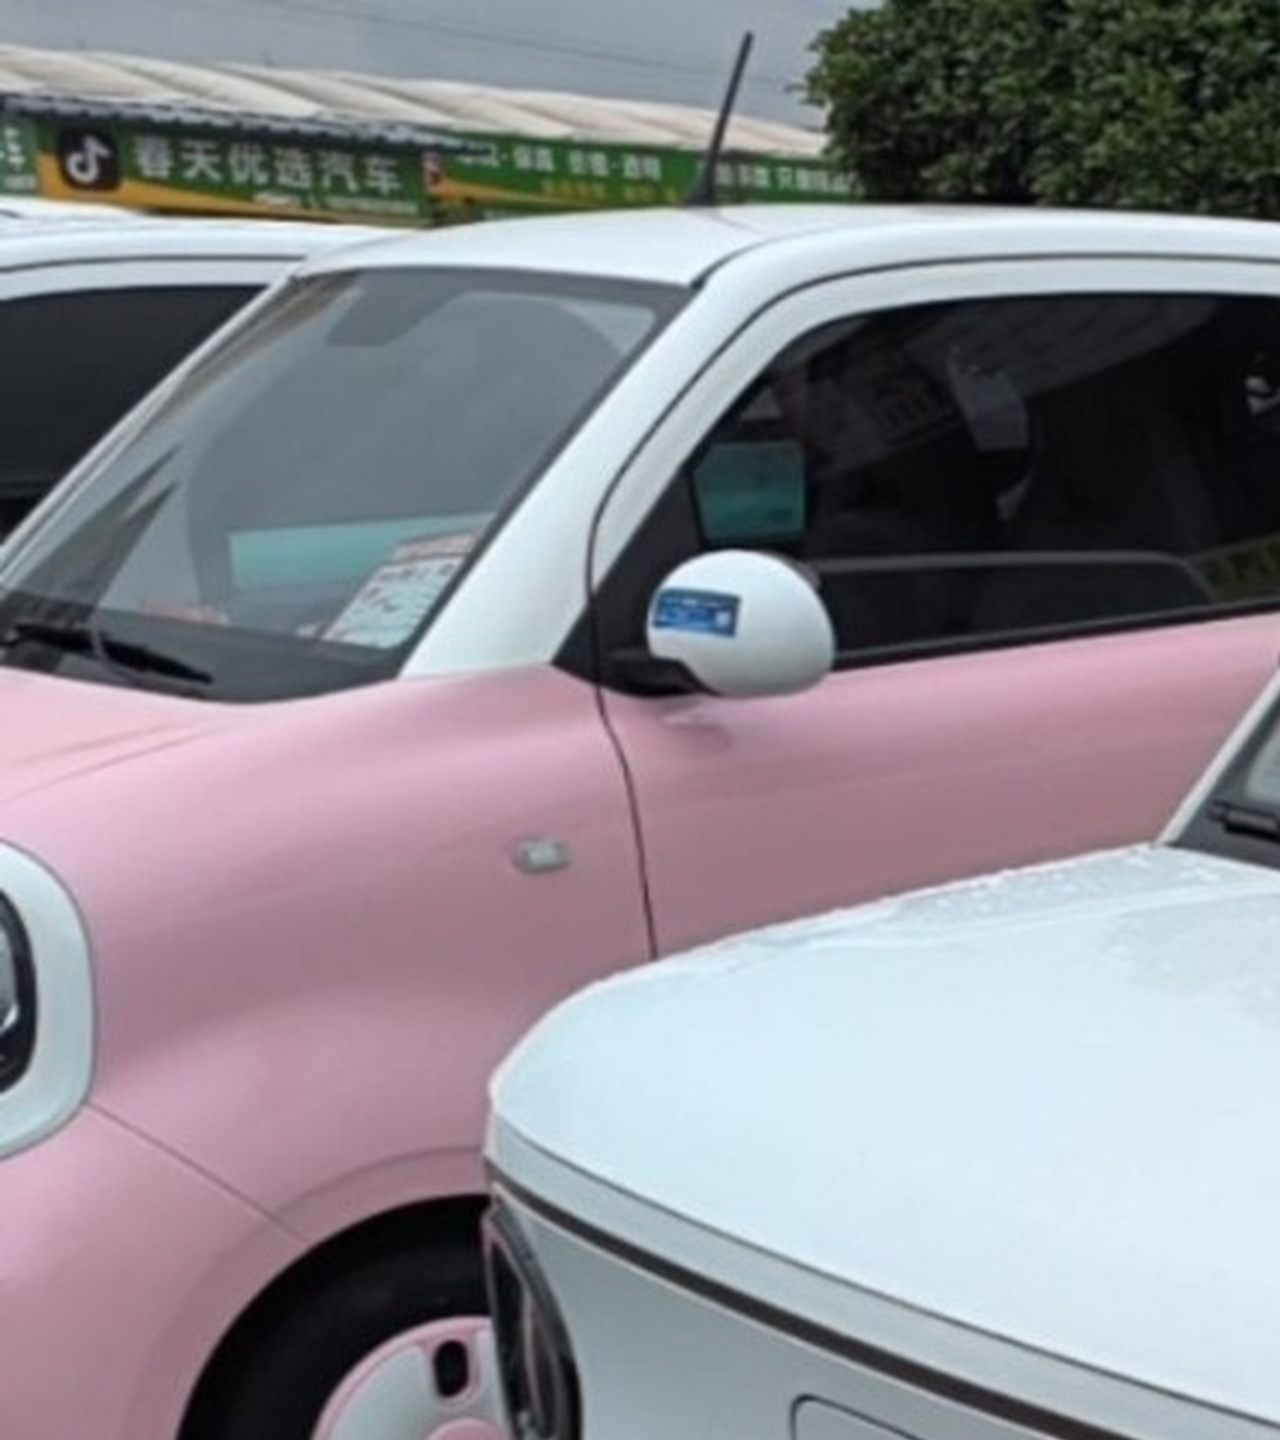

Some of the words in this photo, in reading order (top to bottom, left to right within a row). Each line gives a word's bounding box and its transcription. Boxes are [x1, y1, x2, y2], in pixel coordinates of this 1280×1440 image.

[134, 137, 400, 196] 春天优选汽车
